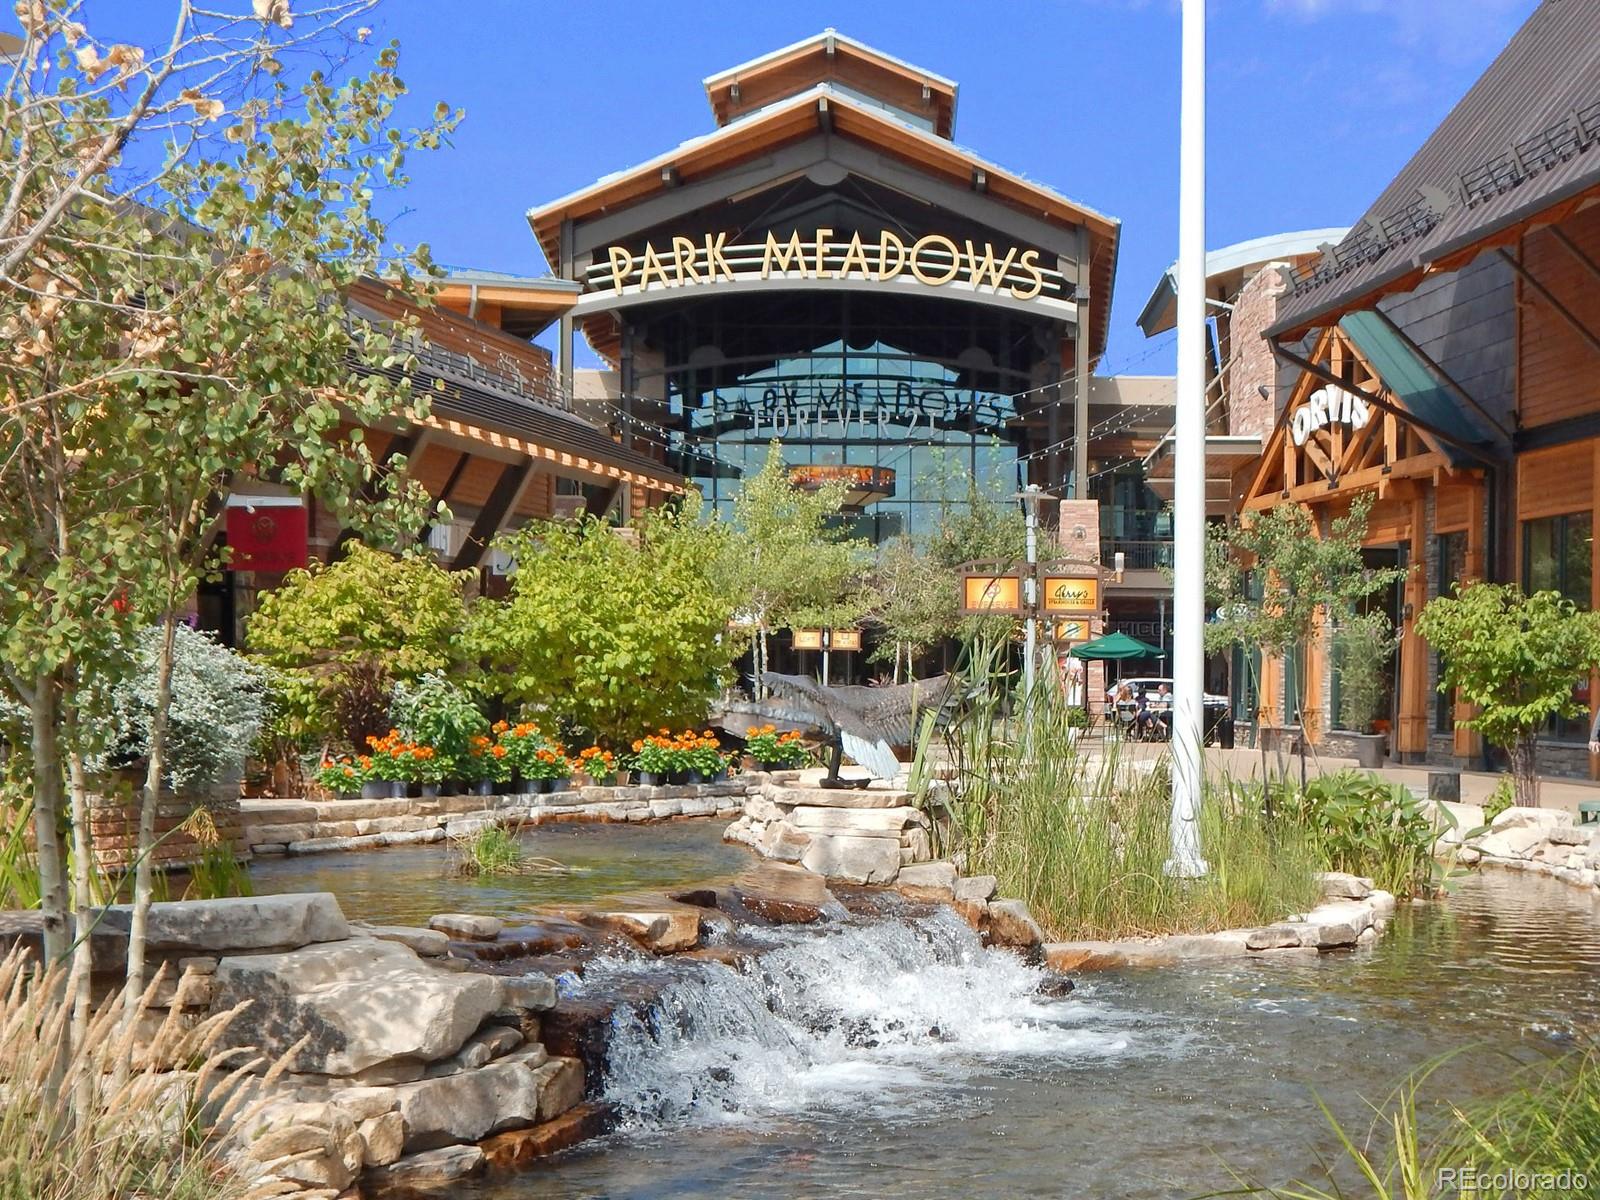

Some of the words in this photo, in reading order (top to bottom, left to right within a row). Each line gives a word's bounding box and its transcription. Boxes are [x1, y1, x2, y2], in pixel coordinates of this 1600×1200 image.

[608, 232, 735, 296] PARK
[761, 228, 1045, 300] MEADOWS
[753, 407, 891, 439] FOREVER
[903, 407, 938, 439] 21
[1292, 383, 1369, 446] ORVIS
[1055, 584, 1089, 600] Perry's
